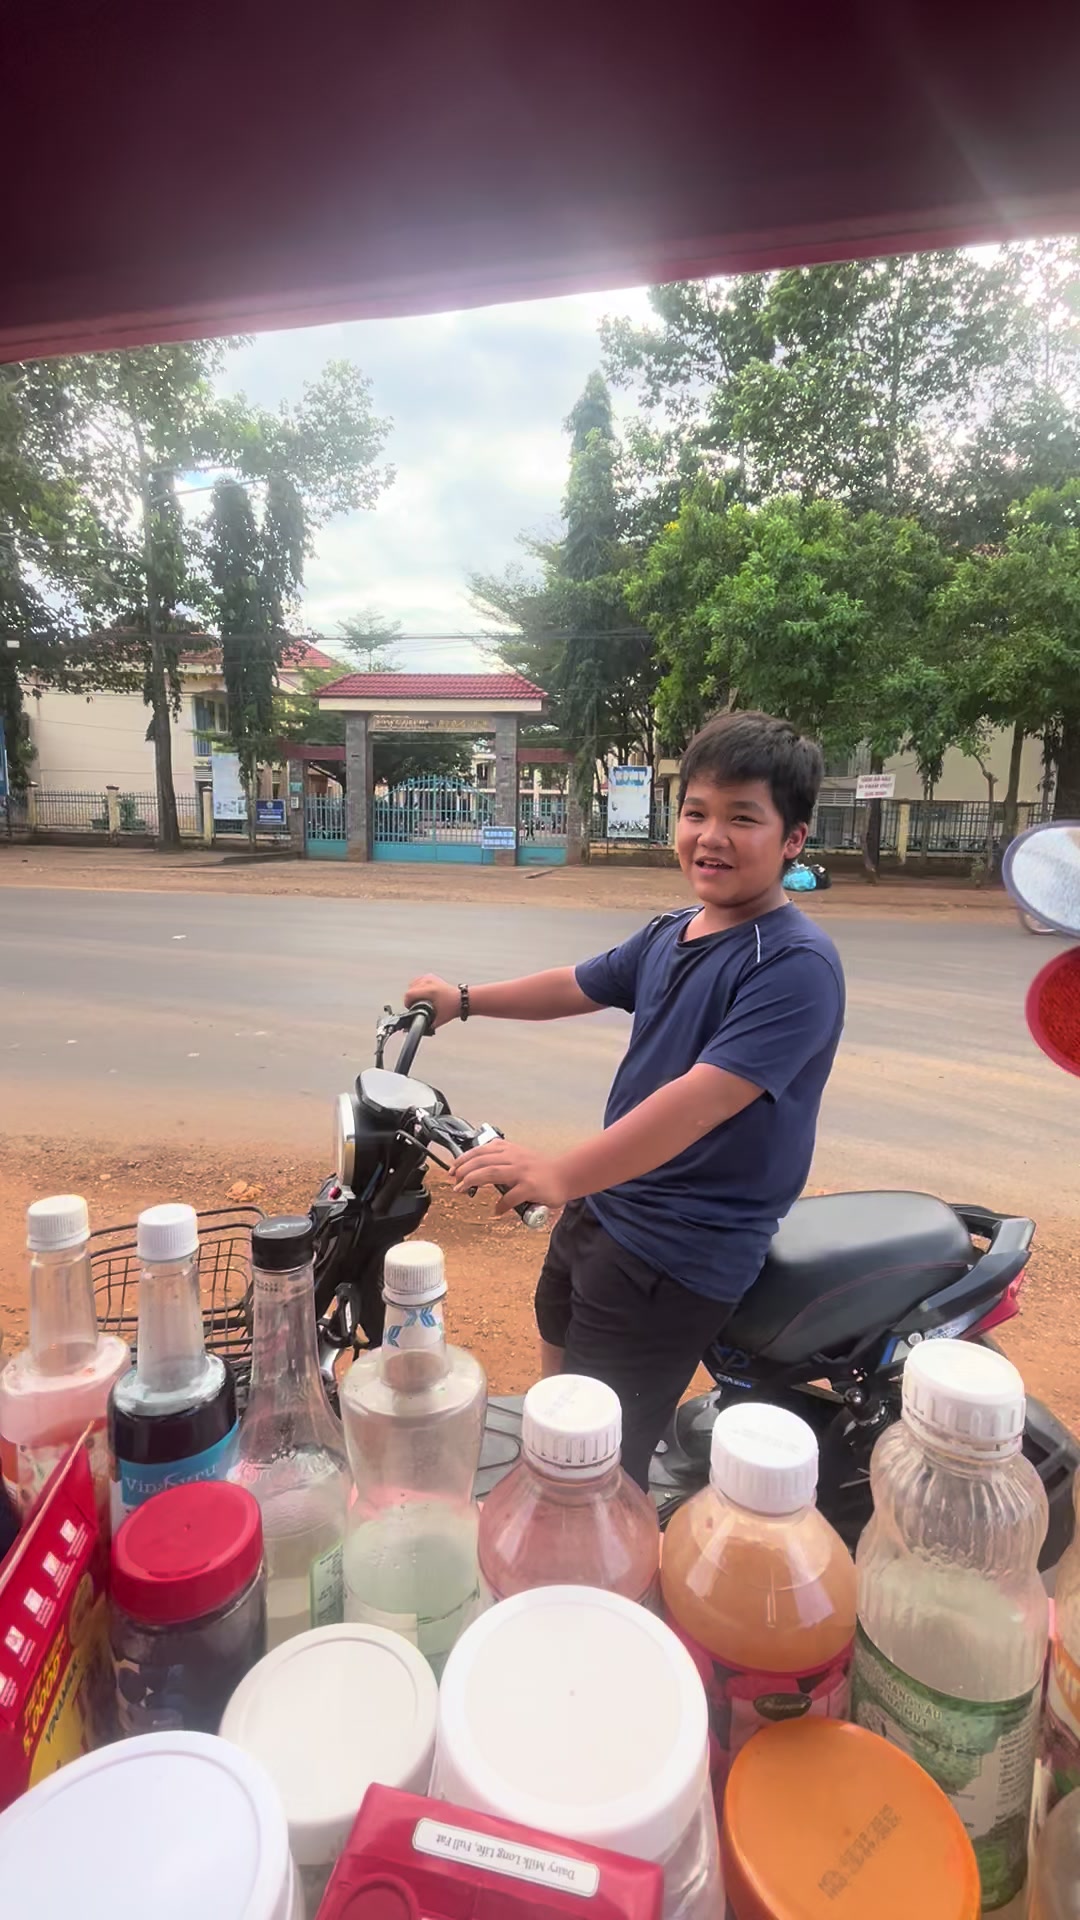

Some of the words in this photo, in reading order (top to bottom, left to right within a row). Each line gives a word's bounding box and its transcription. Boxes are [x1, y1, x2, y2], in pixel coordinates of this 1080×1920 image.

[435, 1833, 453, 1848] Fat
[452, 1838, 473, 1853] Full
[496, 1847, 521, 1866] Long
[523, 1857, 545, 1873] Milk
[547, 1861, 576, 1881] Dairy
